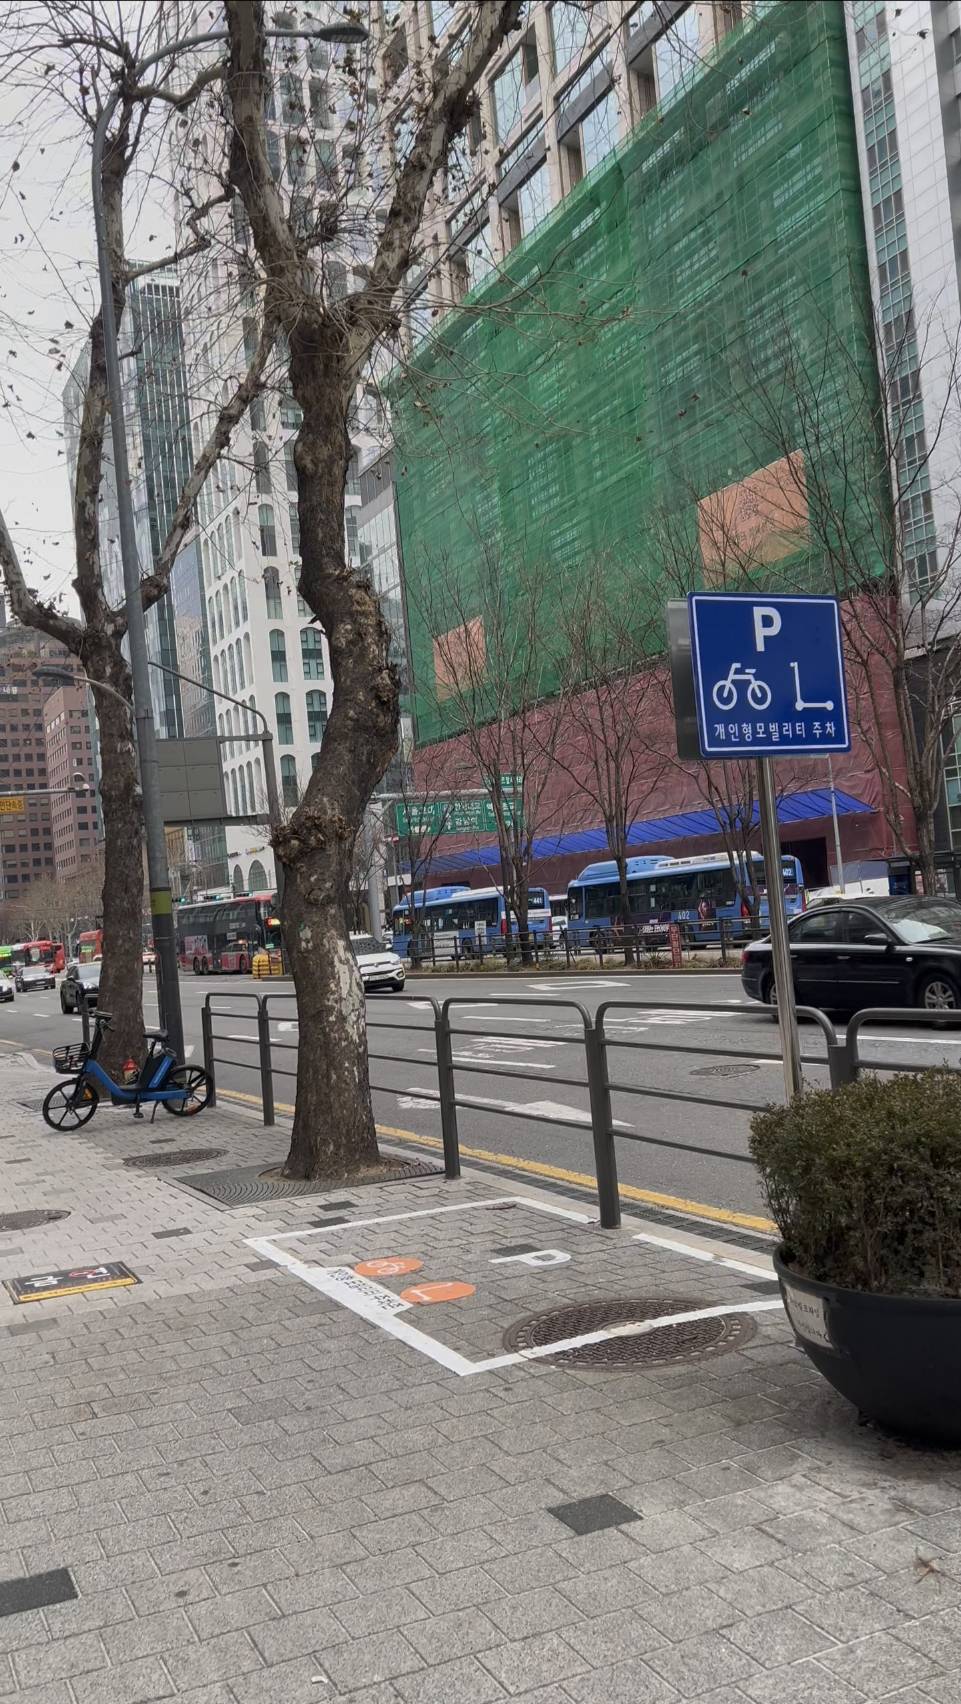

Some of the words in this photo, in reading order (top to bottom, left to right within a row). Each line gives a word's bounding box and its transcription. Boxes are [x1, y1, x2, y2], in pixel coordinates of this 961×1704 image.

[753, 606, 782, 652] P
[713, 721, 806, 742] 개인형모빌리티
[812, 721, 836, 739] 주차
[488, 1248, 572, 1267] P
